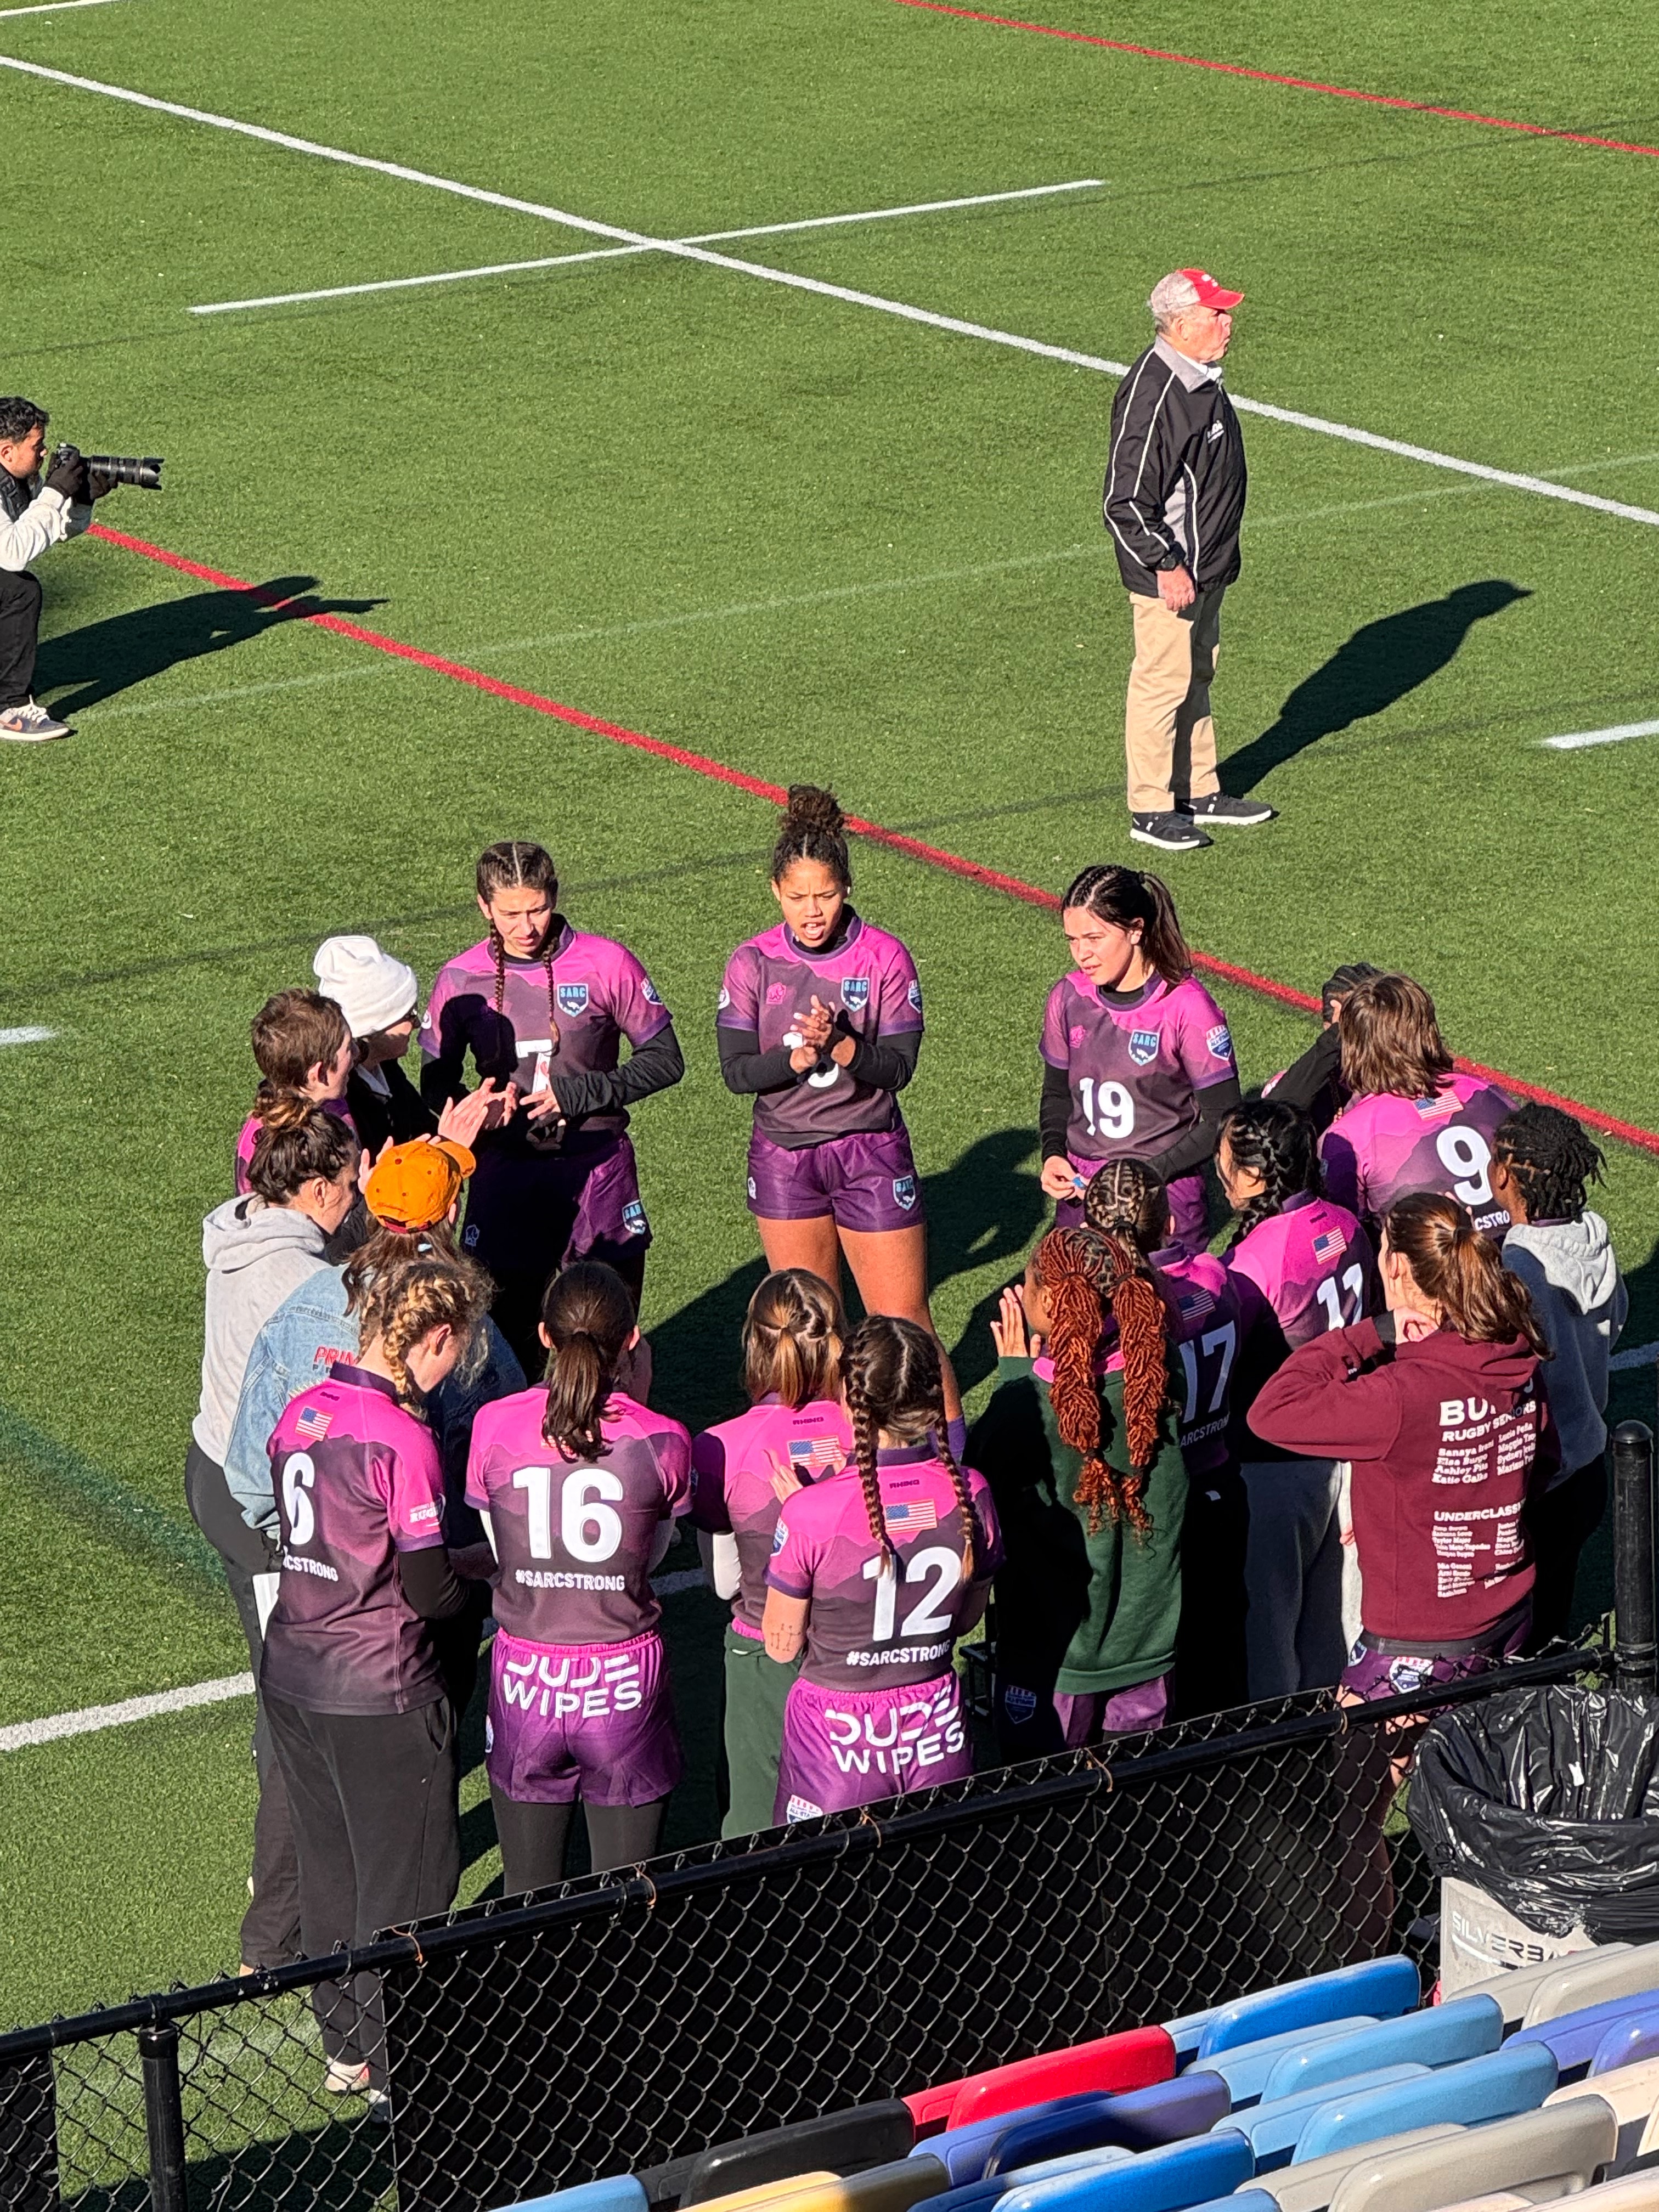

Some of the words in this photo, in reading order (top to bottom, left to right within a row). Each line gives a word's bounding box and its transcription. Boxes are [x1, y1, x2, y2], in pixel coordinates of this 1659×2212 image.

[560, 986, 585, 997] SARC
[1079, 1077, 1134, 1139] 19
[1436, 1126, 1493, 1205] 9
[1178, 1320, 1236, 1424] 17
[1442, 1421, 1491, 1442] RUGBY
[282, 1452, 315, 1545] 6
[513, 1466, 623, 1562] 16
[515, 1569, 625, 1591] #SARCSTRONG
[863, 1547, 961, 1641] 12
[846, 1639, 951, 1667] #SARCSTRONG
[503, 1674, 642, 1719] WIPES
[830, 1720, 964, 1775] WIPES
